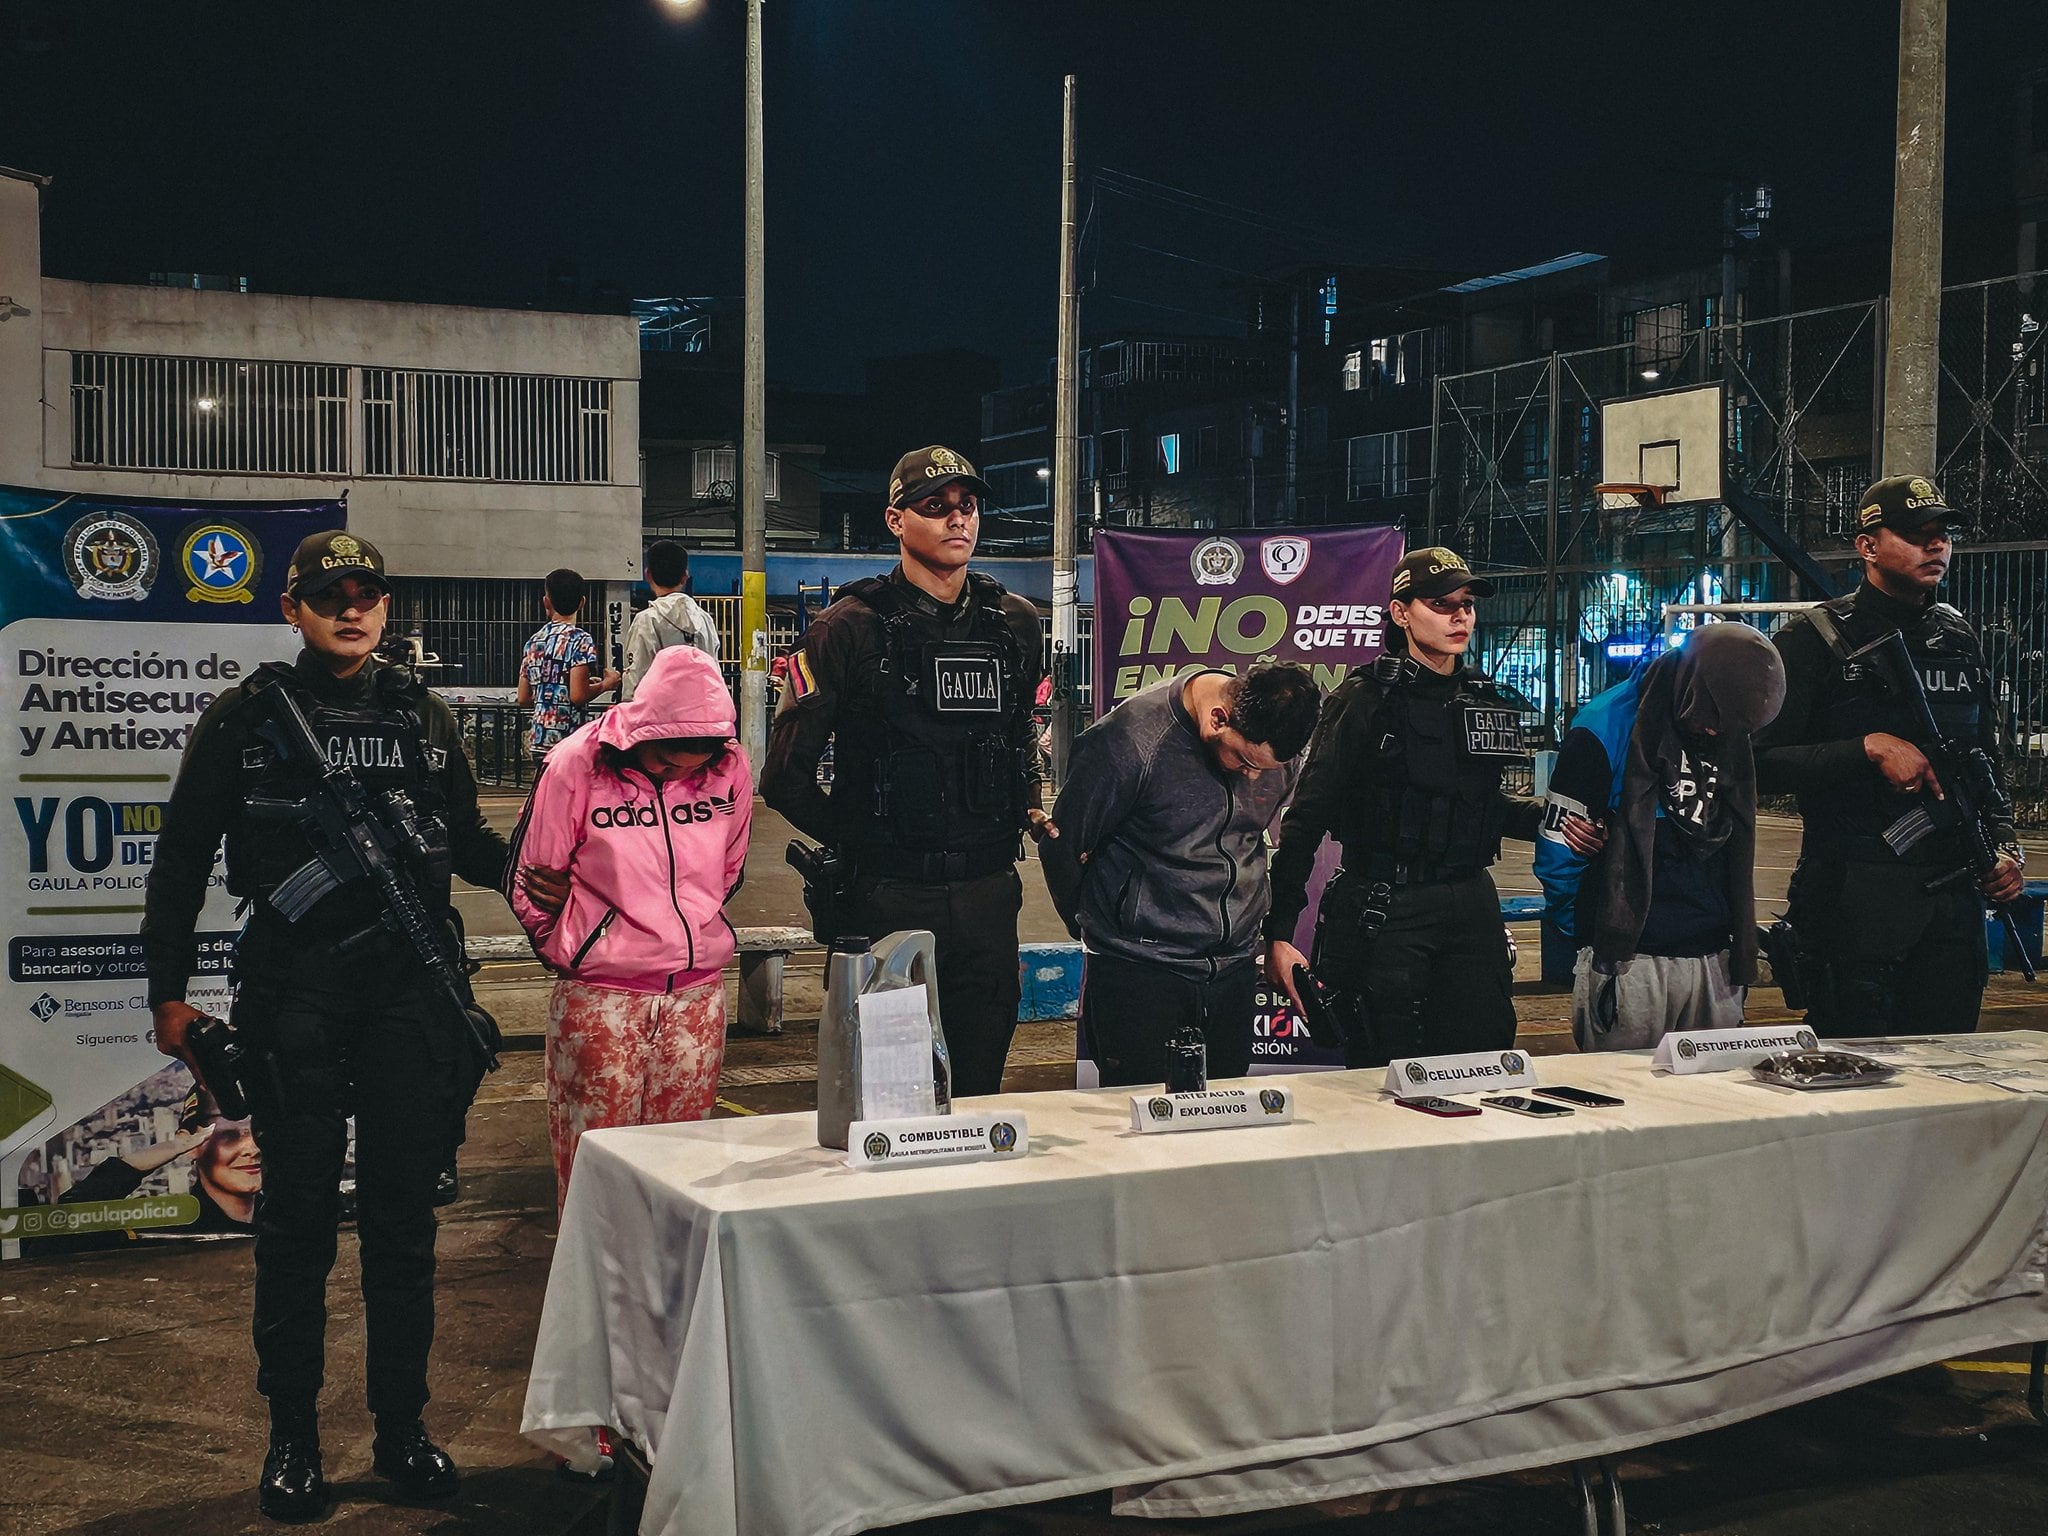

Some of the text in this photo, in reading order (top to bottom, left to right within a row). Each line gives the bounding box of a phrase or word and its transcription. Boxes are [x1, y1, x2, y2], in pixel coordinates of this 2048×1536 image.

[925, 464, 969, 479] GAULA
[321, 556, 375, 570] GAULA
[1295, 605, 1383, 626] DEJES
[1293, 628, 1383, 650] QUE TE
[18, 648, 241, 680] Dirección de
[941, 671, 997, 700] GAULA
[1925, 669, 1972, 693] ULA
[19, 681, 218, 713] Antisecue
[1475, 712, 1519, 732] GAULA
[19, 727, 47, 757] y
[1471, 731, 1526, 751] POLICIA
[327, 735, 405, 768] GAULA
[122, 805, 161, 832] NO
[590, 800, 713, 829] adidas
[13, 796, 114, 874] YO
[28, 873, 149, 891] GAULA POLICÍ
[22, 945, 56, 958] Para
[60, 942, 126, 957] asesoría
[213, 939, 234, 952] de
[21, 962, 92, 976] bancario
[95, 963, 105, 977] y
[108, 961, 147, 973] otros
[64, 998, 124, 1012] Bensons
[76, 1034, 138, 1047] Síguenos
[1696, 1036, 1797, 1052] ESTUPEFACIENTES
[1428, 1065, 1502, 1081] CELULARES
[1180, 1104, 1248, 1117] EXPLOSIVOS
[899, 1127, 985, 1143] COMBUSTIBLE
[48, 1202, 178, 1229] @gaulapolicia
